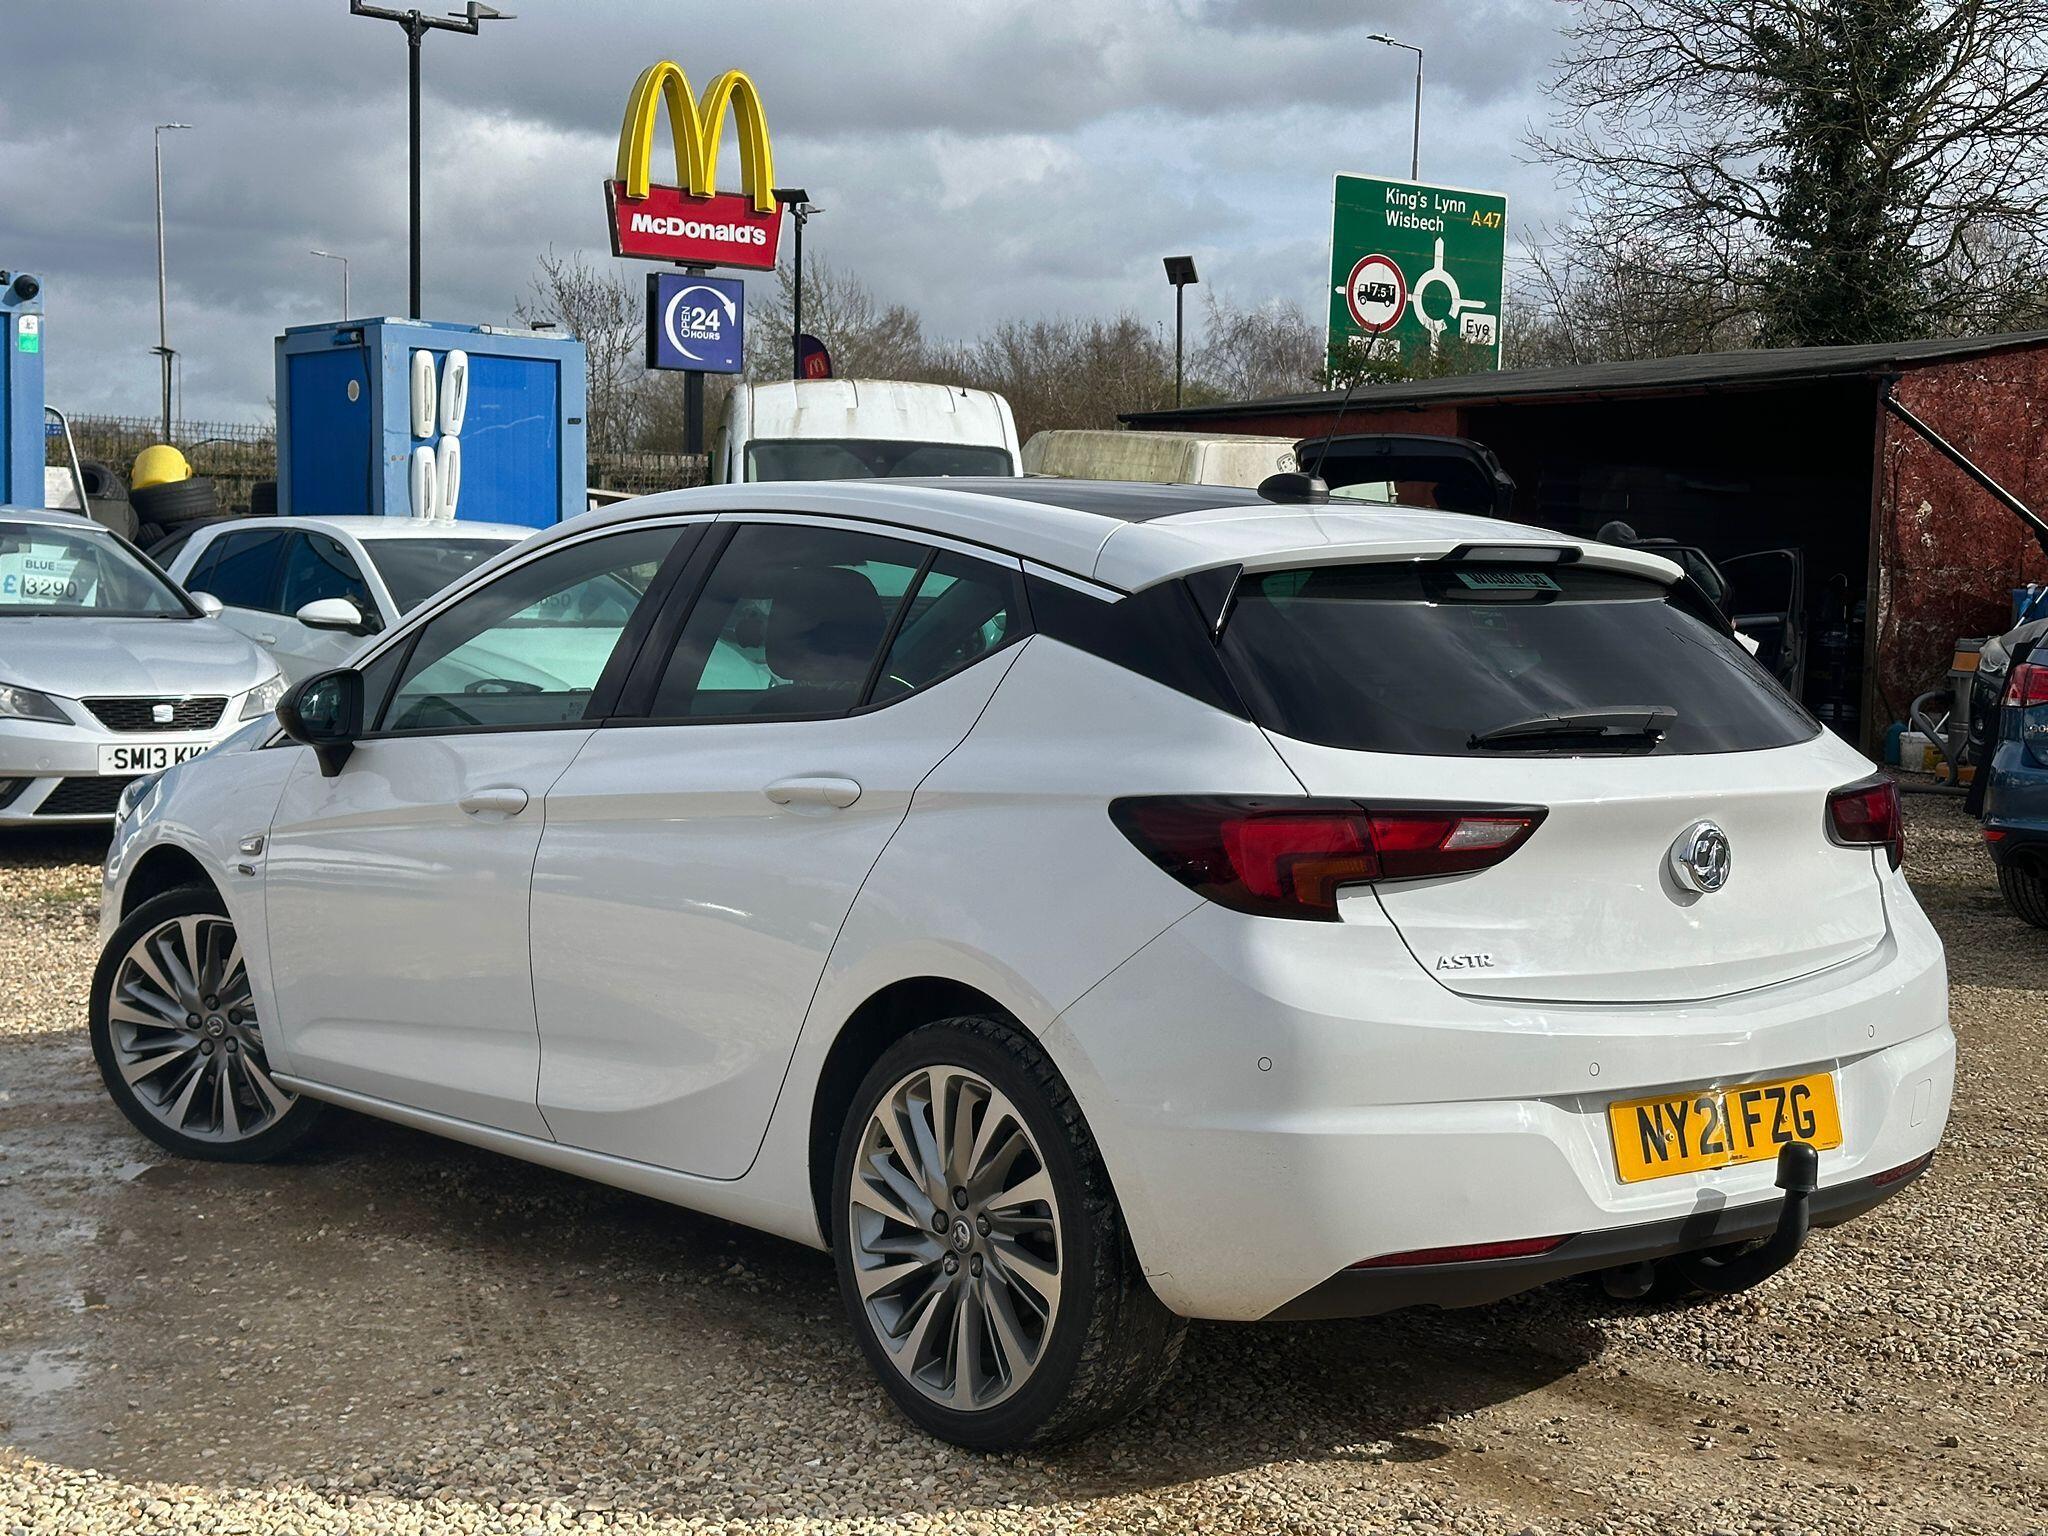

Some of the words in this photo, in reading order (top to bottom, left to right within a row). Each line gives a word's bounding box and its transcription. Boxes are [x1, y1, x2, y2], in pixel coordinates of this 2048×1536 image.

[1386, 187, 1428, 210] King's
[1435, 194, 1466, 214] Lynn
[630, 213, 767, 246] McDonald's
[1385, 209, 1444, 232] Wisbech
[1471, 210, 1502, 229] A47
[680, 306, 691, 338] OPEN
[690, 306, 721, 332] 24
[1466, 319, 1490, 339] Eye
[690, 330, 721, 341] HOURS
[25, 559, 55, 571] BLUE
[26, 577, 78, 598] 3290
[114, 747, 167, 769] SM13
[1636, 1095, 1735, 1164] NY21
[1739, 1084, 1816, 1148] FZG
